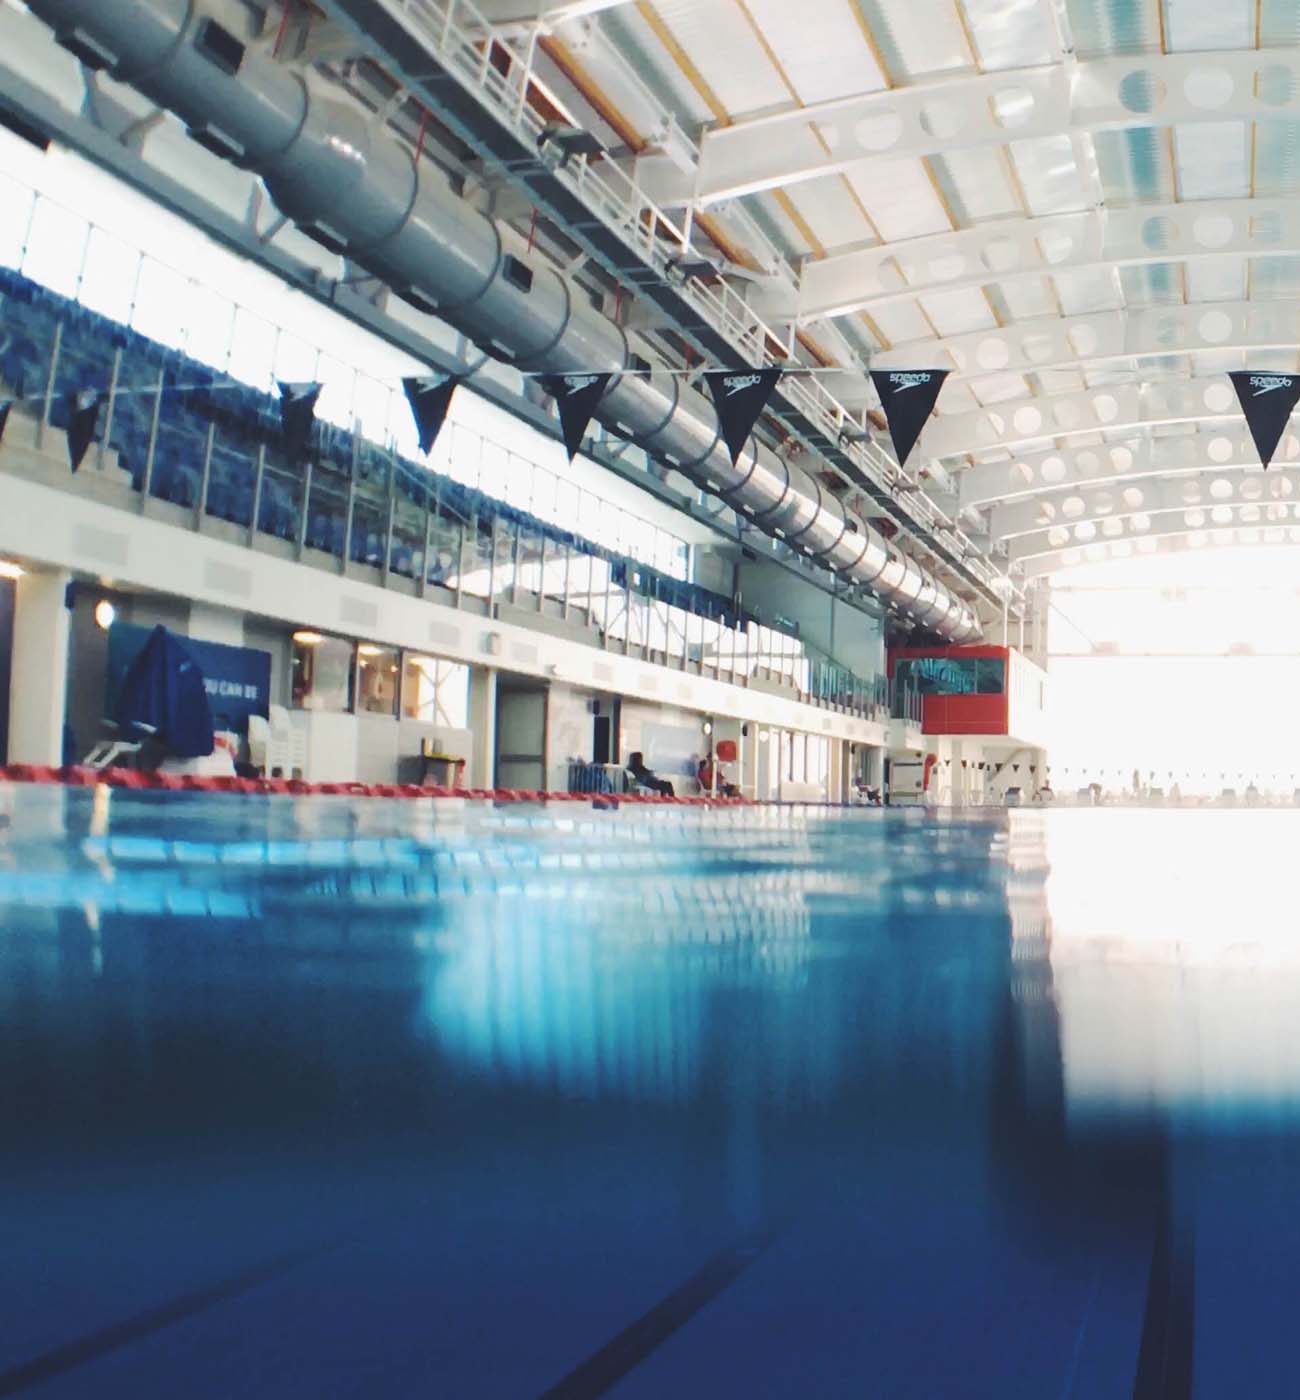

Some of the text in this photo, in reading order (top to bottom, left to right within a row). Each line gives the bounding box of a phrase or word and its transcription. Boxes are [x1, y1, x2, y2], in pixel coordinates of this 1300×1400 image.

[724, 374, 762, 387] speedo
[890, 372, 931, 384] speedo
[1250, 376, 1292, 388] speedo
[220, 681, 242, 697] CAN
